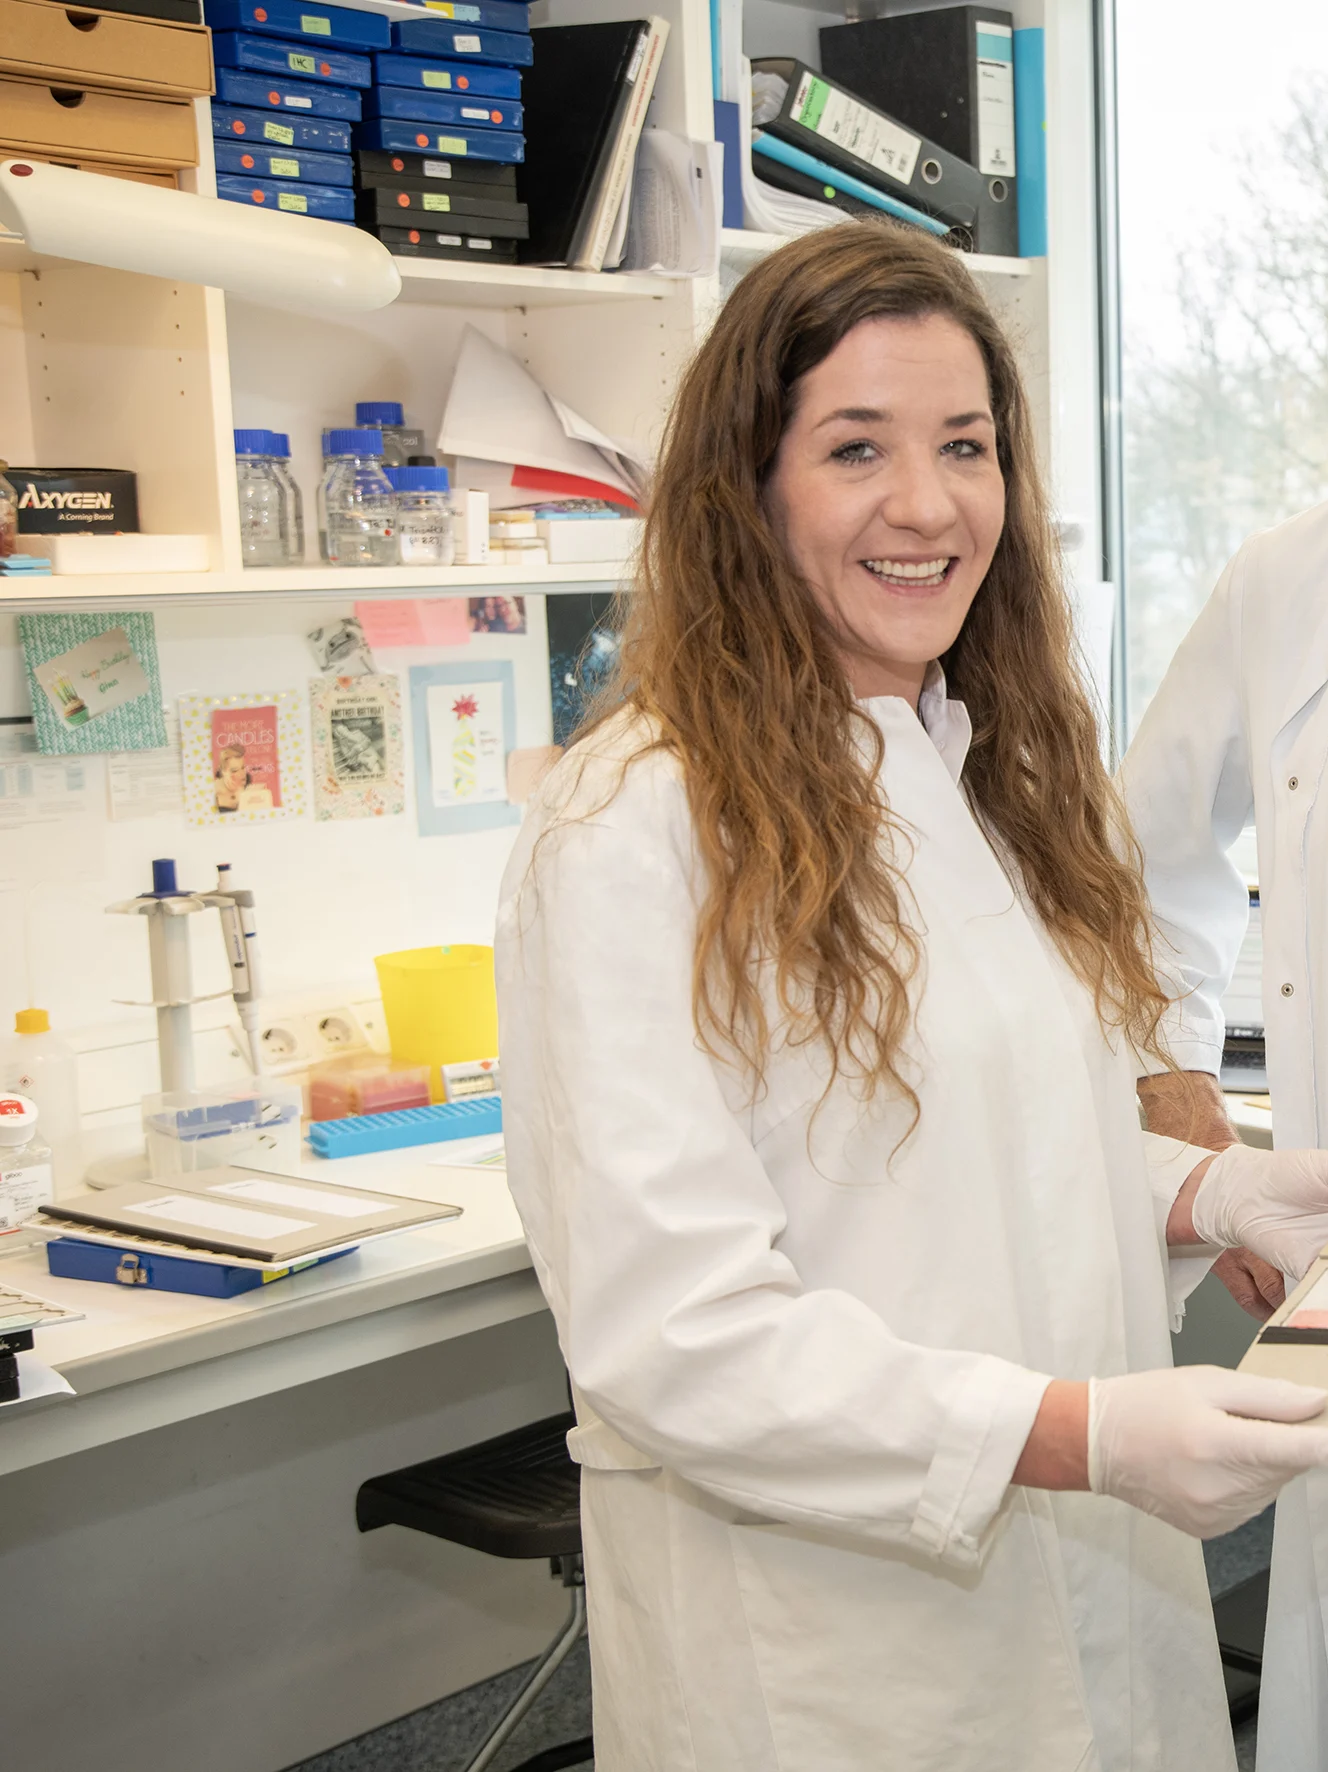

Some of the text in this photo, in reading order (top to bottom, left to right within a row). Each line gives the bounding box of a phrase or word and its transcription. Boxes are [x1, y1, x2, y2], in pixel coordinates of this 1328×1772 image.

[19, 483, 112, 509] AXYGEN
[58, 513, 114, 523] A Corning Brand
[216, 729, 275, 748] CANDLES
